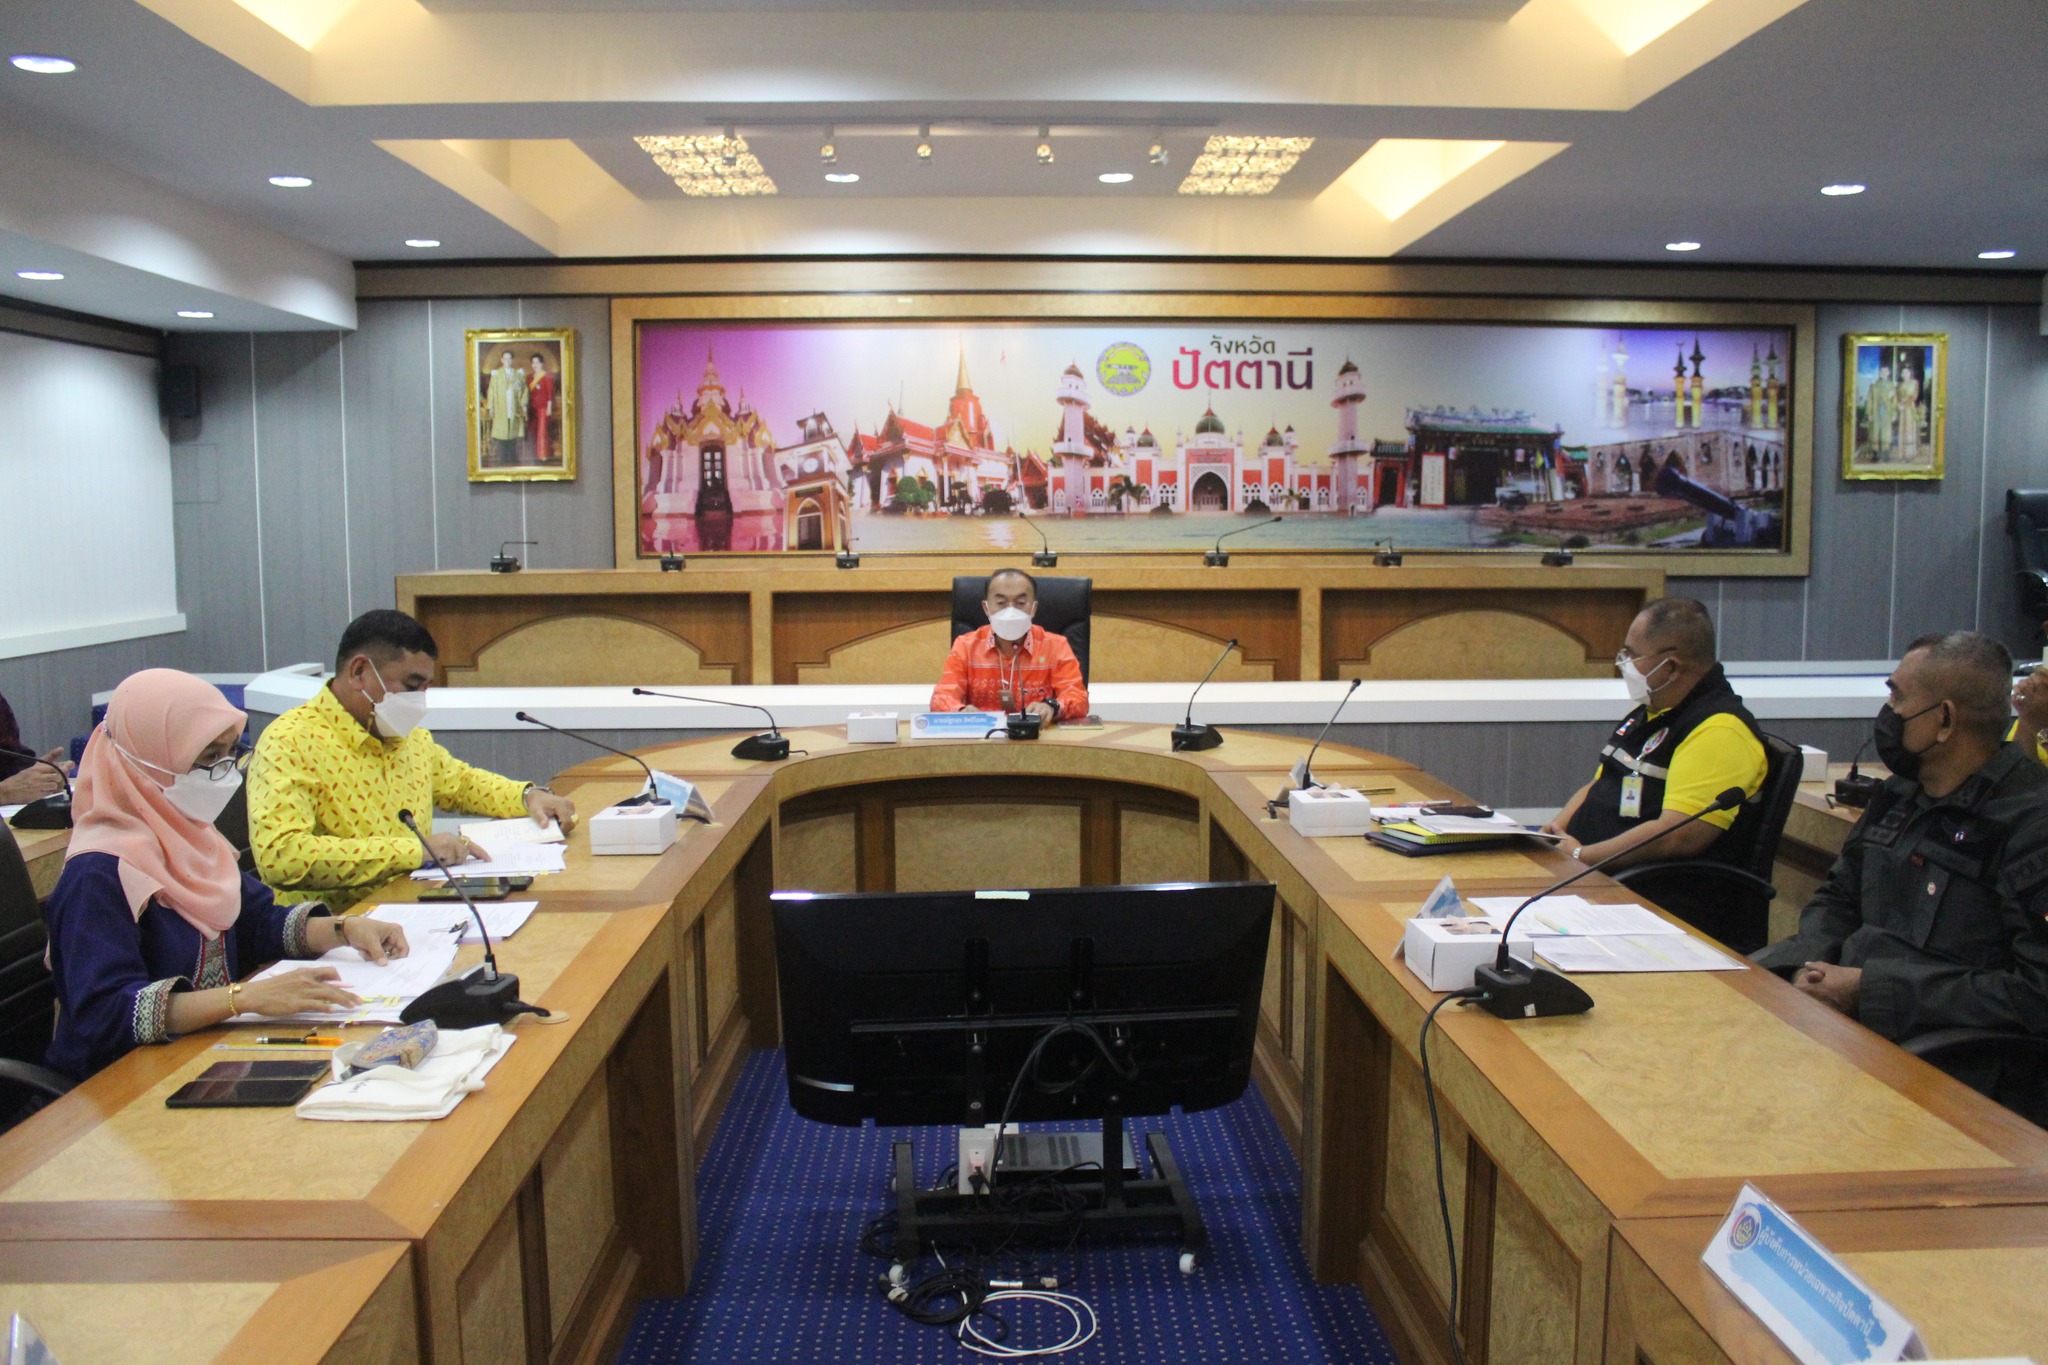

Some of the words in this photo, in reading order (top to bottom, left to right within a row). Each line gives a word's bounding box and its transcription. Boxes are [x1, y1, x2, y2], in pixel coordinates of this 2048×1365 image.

[1209, 334, 1276, 355] จังหวัด
[1172, 346, 1313, 391] ปัตตานี
